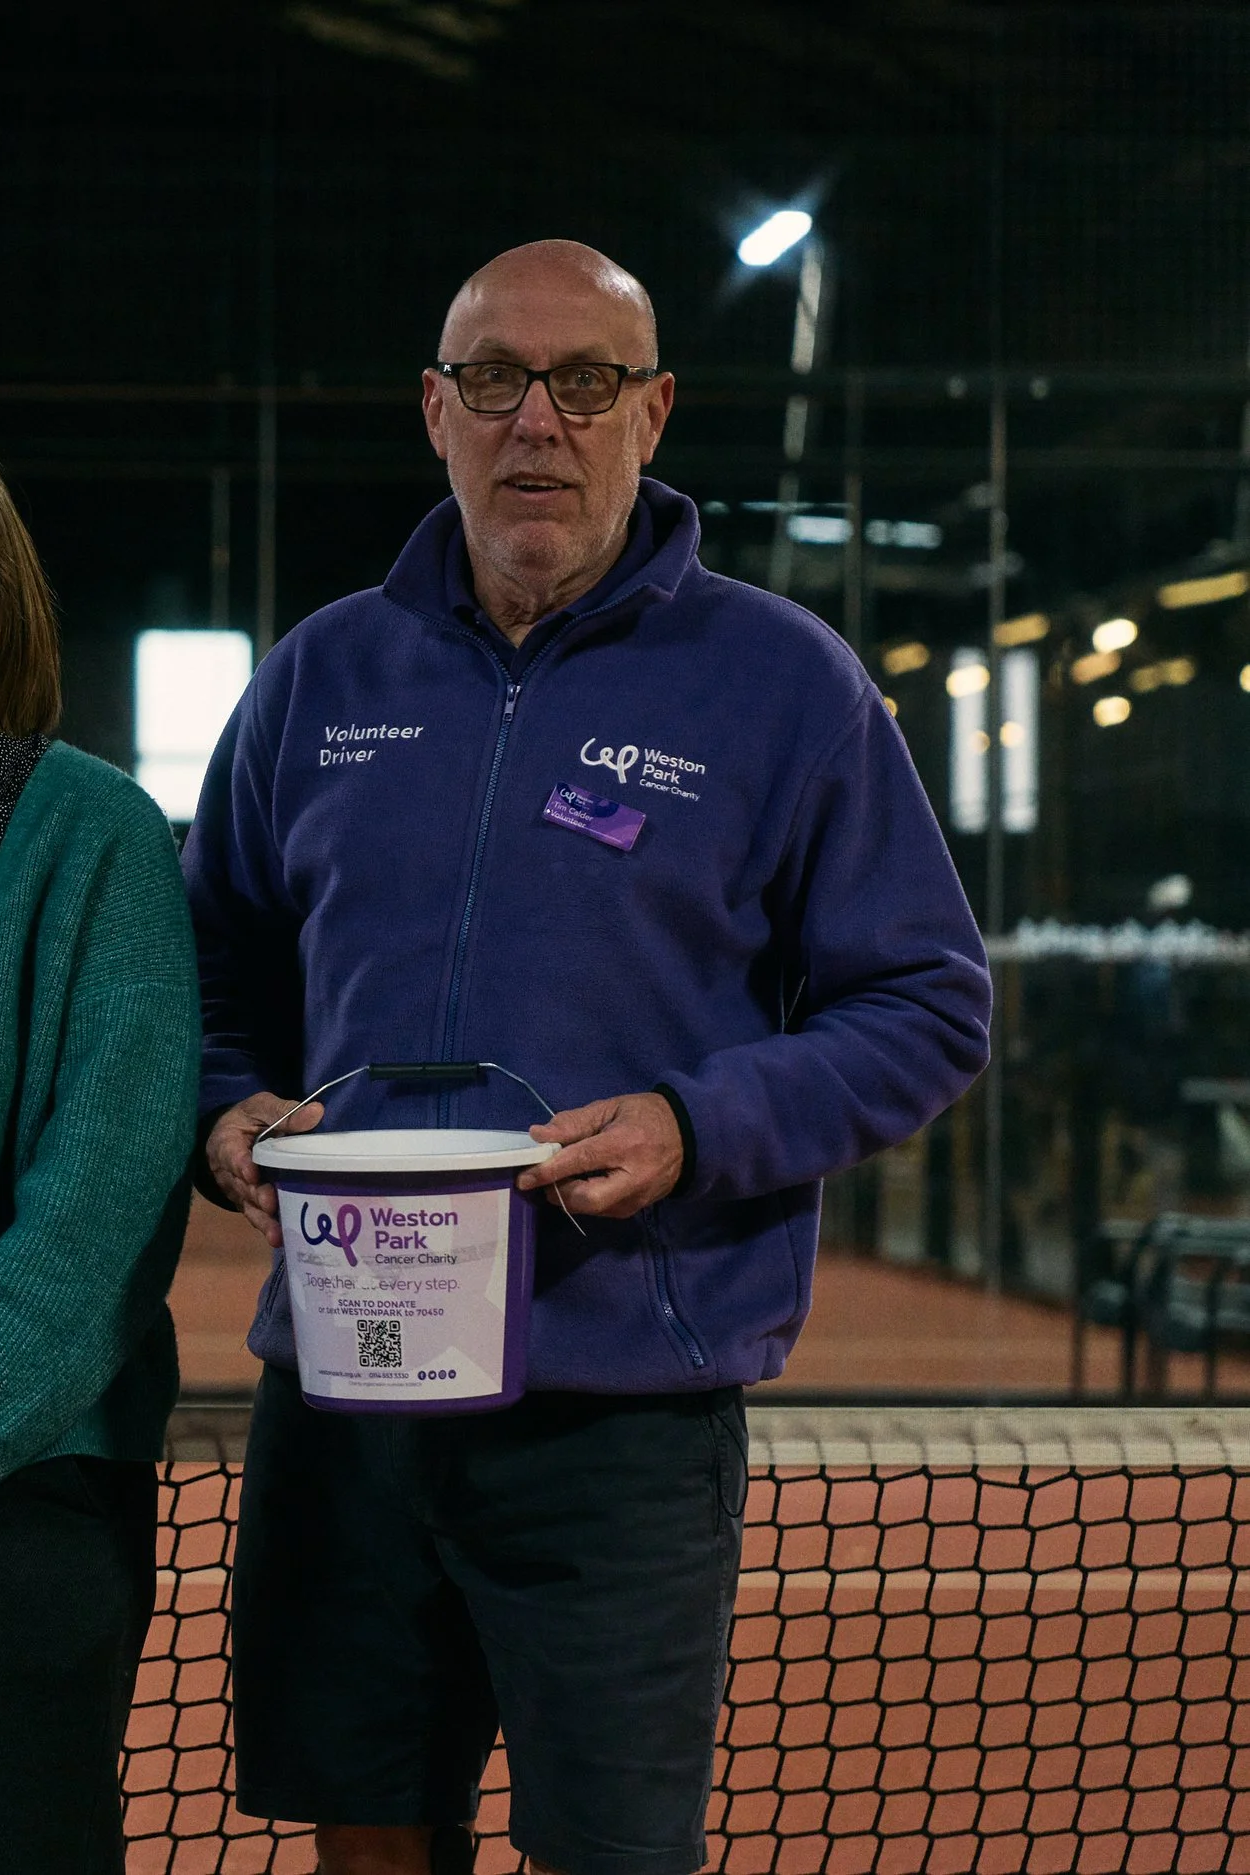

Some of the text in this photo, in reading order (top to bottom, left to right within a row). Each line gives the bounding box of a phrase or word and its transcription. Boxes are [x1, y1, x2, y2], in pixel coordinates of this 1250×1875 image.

[324, 723, 424, 743] Volunteer
[319, 747, 376, 767] Driver
[644, 748, 706, 775] Weston
[642, 763, 681, 784] Park
[639, 778, 700, 802] Cancer Charity
[553, 800, 567, 812] Tim
[551, 808, 587, 828] Volunteer
[369, 1207, 459, 1227] Weston
[375, 1231, 428, 1250] Park
[375, 1253, 458, 1265] Cancer Charity
[378, 1278, 422, 1294] every
[425, 1277, 460, 1292] step.
[338, 1299, 417, 1308] SCAN TO DONATE
[341, 1308, 402, 1317] WESTONPARK
[404, 1309, 414, 1317] to
[416, 1308, 444, 1317] 70450
